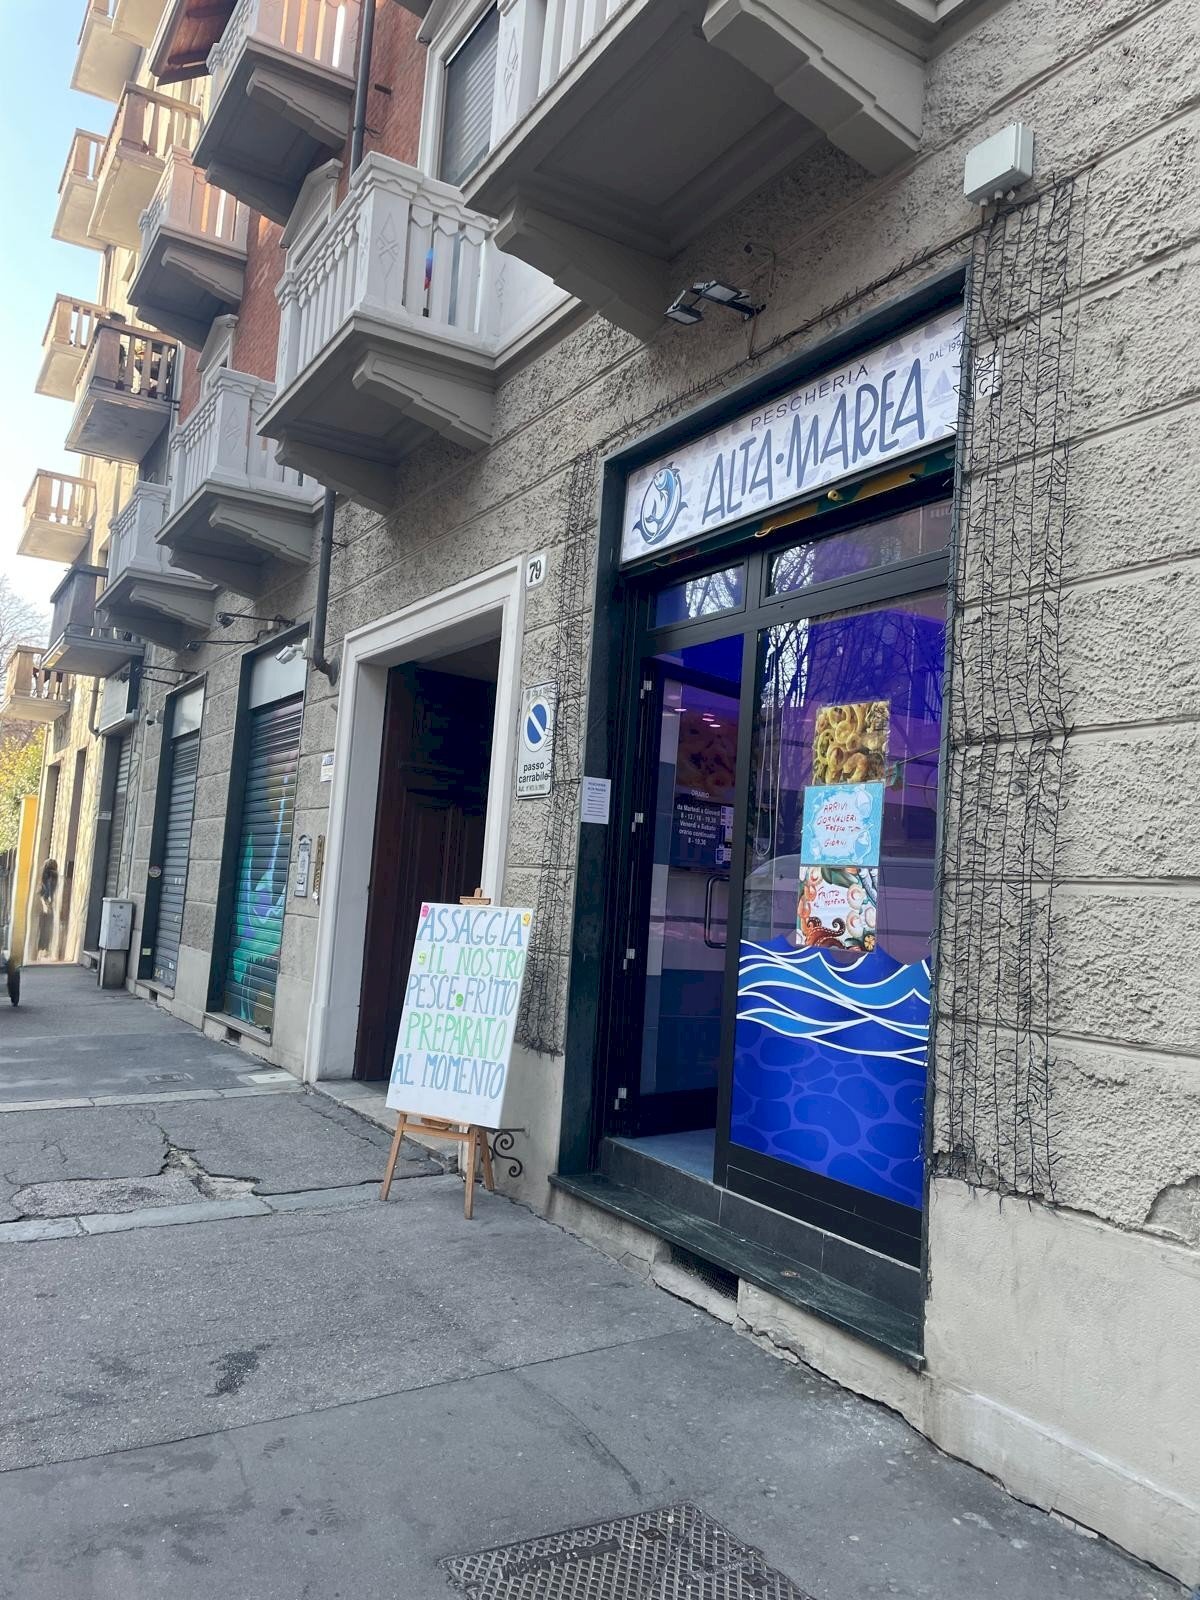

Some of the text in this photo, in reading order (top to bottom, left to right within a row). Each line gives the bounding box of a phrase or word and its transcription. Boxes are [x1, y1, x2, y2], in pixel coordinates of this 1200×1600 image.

[929, 347, 944, 362] DAL
[750, 363, 869, 431] PESCHERIA
[786, 357, 926, 489] MAREA
[529, 559, 542, 582] 79
[518, 771, 549, 784] carrabile
[523, 761, 545, 774] passo
[823, 801, 848, 813] ARRIVI
[817, 886, 840, 899] FRITTO
[416, 907, 523, 947] ASSAGGIA
[454, 947, 526, 980] NOSTRO
[405, 973, 521, 1017] PESCE FRITTO
[404, 1011, 508, 1062] PREPARATO
[391, 1053, 506, 1100] AL MOMENTO
